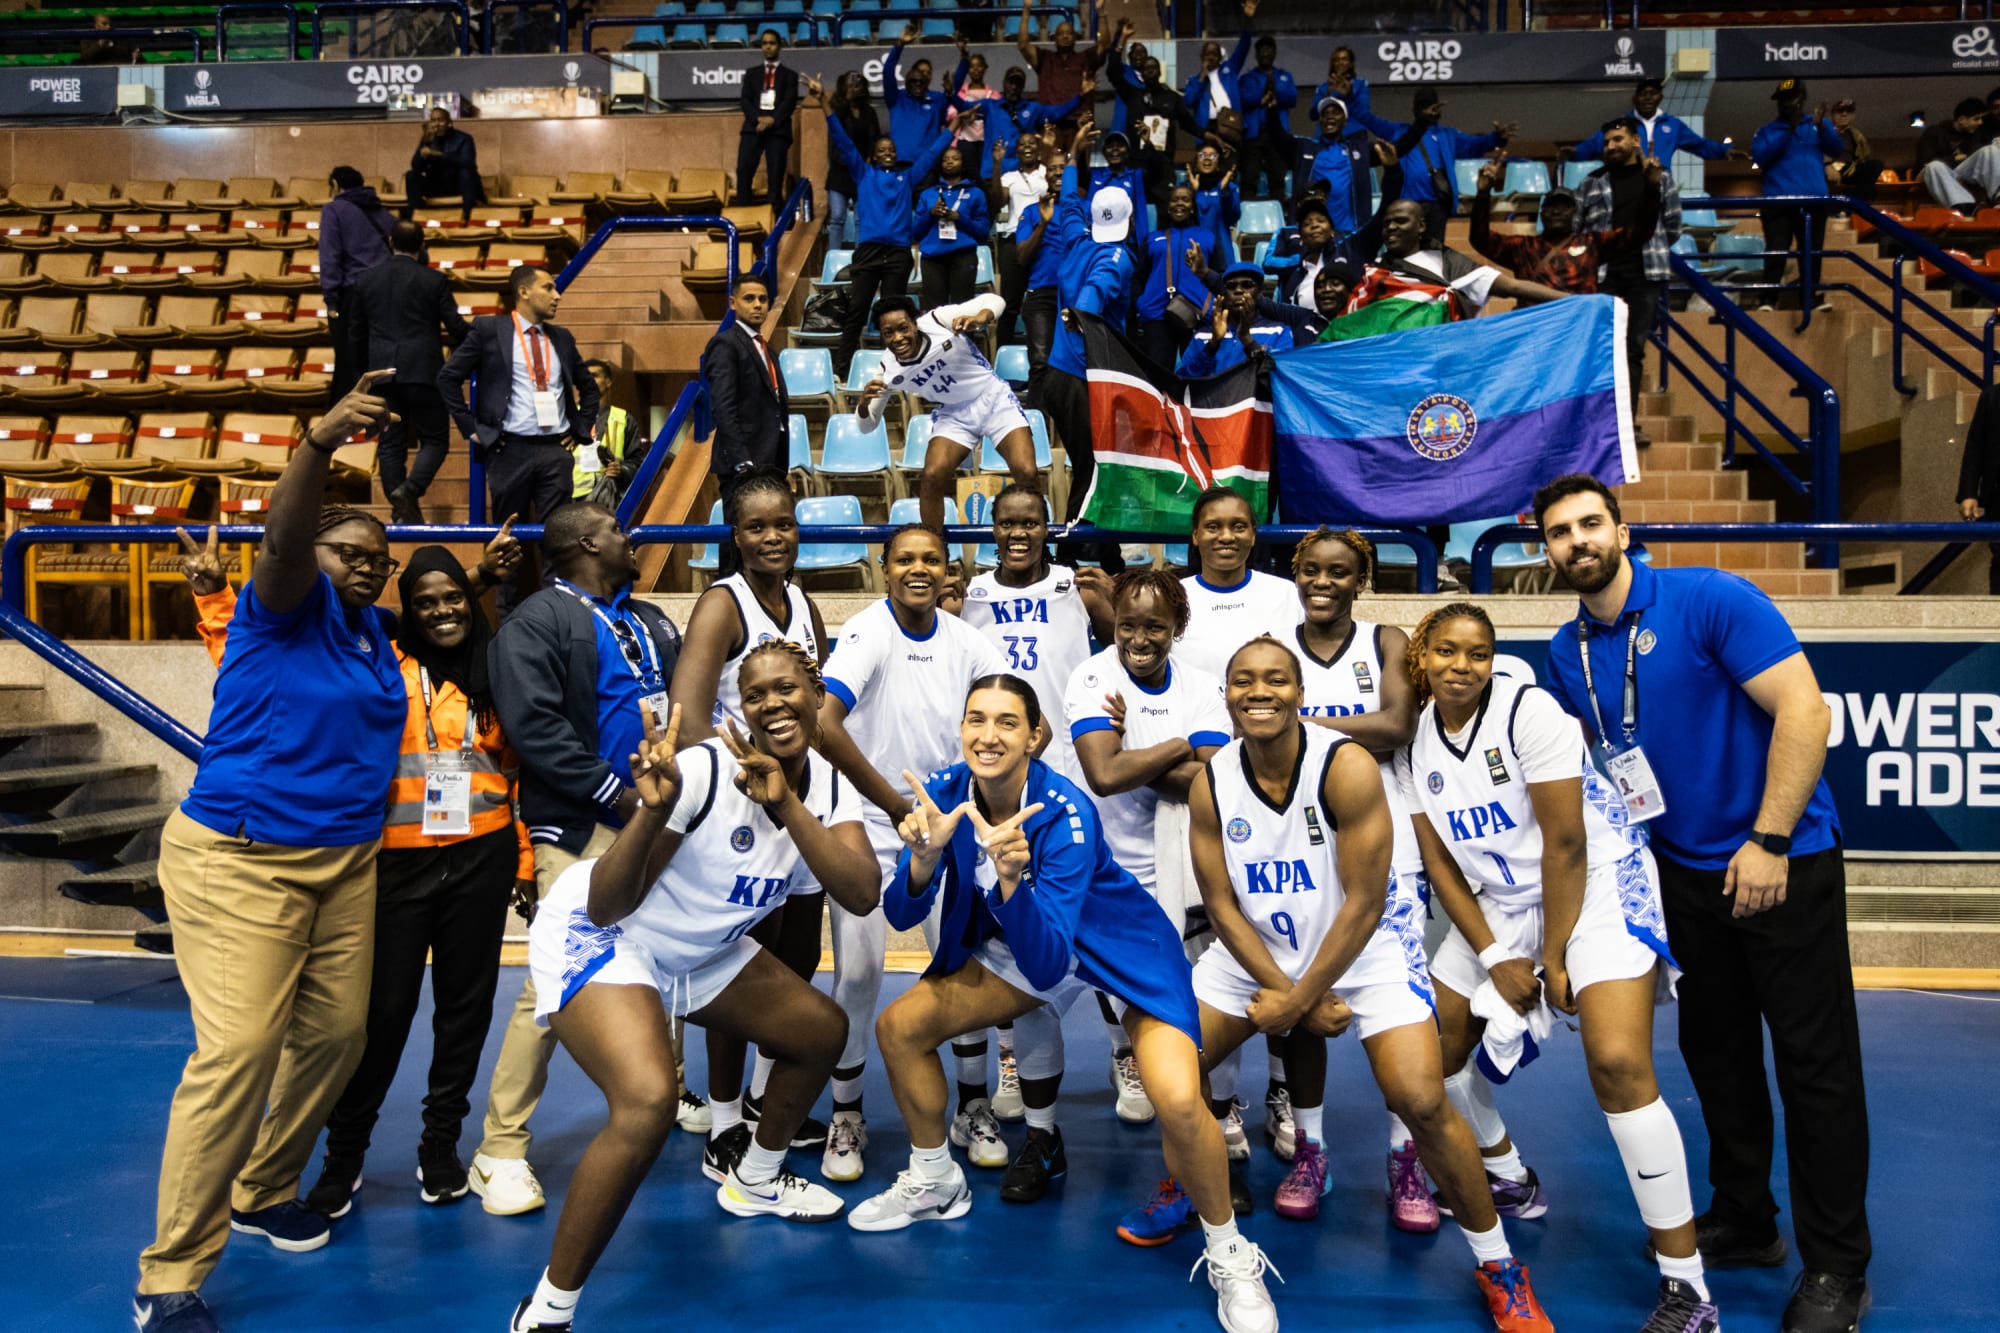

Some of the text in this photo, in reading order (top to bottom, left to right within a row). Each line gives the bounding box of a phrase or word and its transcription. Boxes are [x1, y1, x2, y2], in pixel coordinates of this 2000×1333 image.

[1378, 40, 1462, 61] CAIRO
[1764, 41, 1828, 61] halan
[347, 64, 424, 84] CAIRO
[1388, 61, 1454, 81] 2025
[30, 78, 81, 91] POWER
[53, 91, 81, 103] ADE
[911, 358, 947, 387] KPA
[932, 375, 957, 394] 44
[989, 597, 1049, 625] KPA
[1211, 602, 1245, 612] uhlsport
[1002, 635, 1039, 671] 33
[1866, 751, 2000, 807] ADE
[1445, 800, 1518, 842] KPA
[1244, 858, 1317, 894] KPA
[1270, 911, 1299, 951] 9
